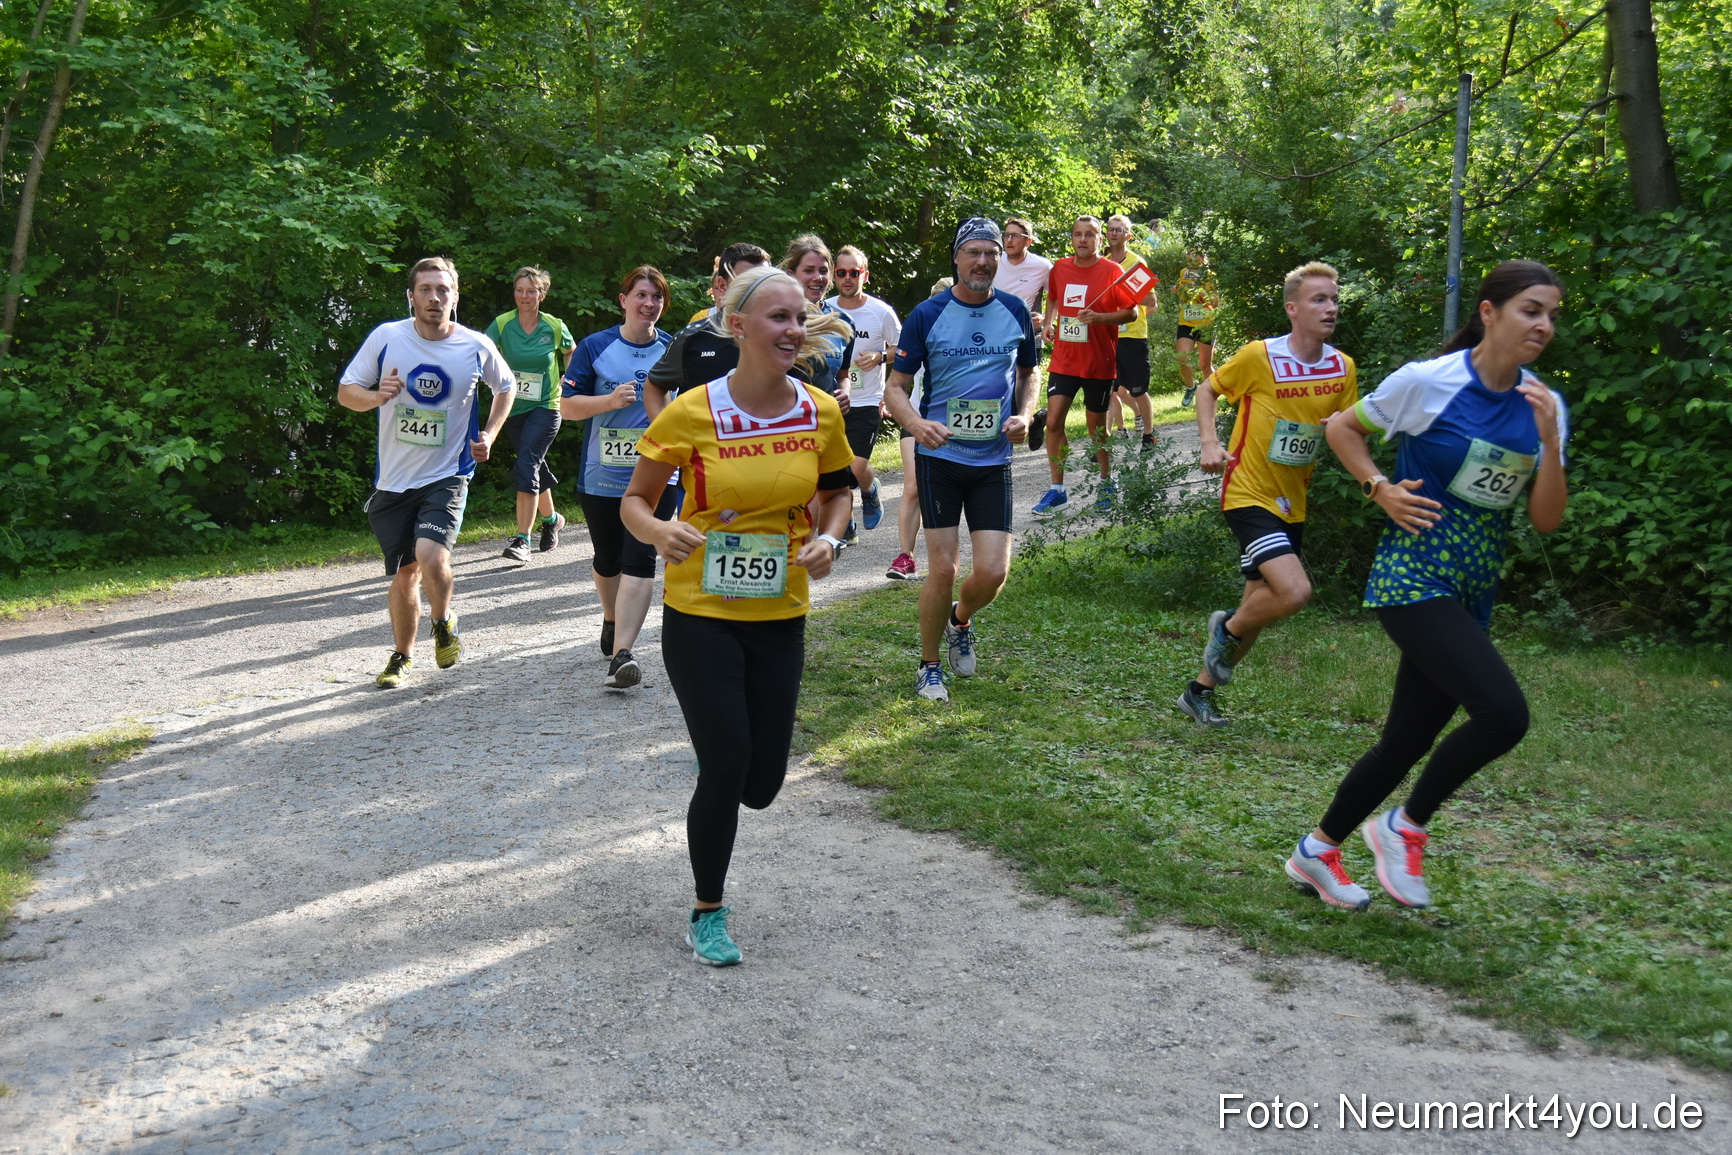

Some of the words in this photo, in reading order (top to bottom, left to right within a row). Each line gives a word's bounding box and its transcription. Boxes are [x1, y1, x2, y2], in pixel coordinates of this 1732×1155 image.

[1063, 325, 1080, 336] 540
[942, 346, 1014, 357] SCHABMÜLLER
[418, 378, 440, 389] TÜV
[1276, 387, 1309, 399] MAX
[400, 420, 438, 438] 2441
[952, 413, 994, 429] 2123
[718, 443, 767, 460] MAX
[772, 436, 820, 454] BÖGL
[1280, 436, 1316, 455] 1690
[1472, 467, 1518, 495] 262
[715, 554, 778, 580] 1559
